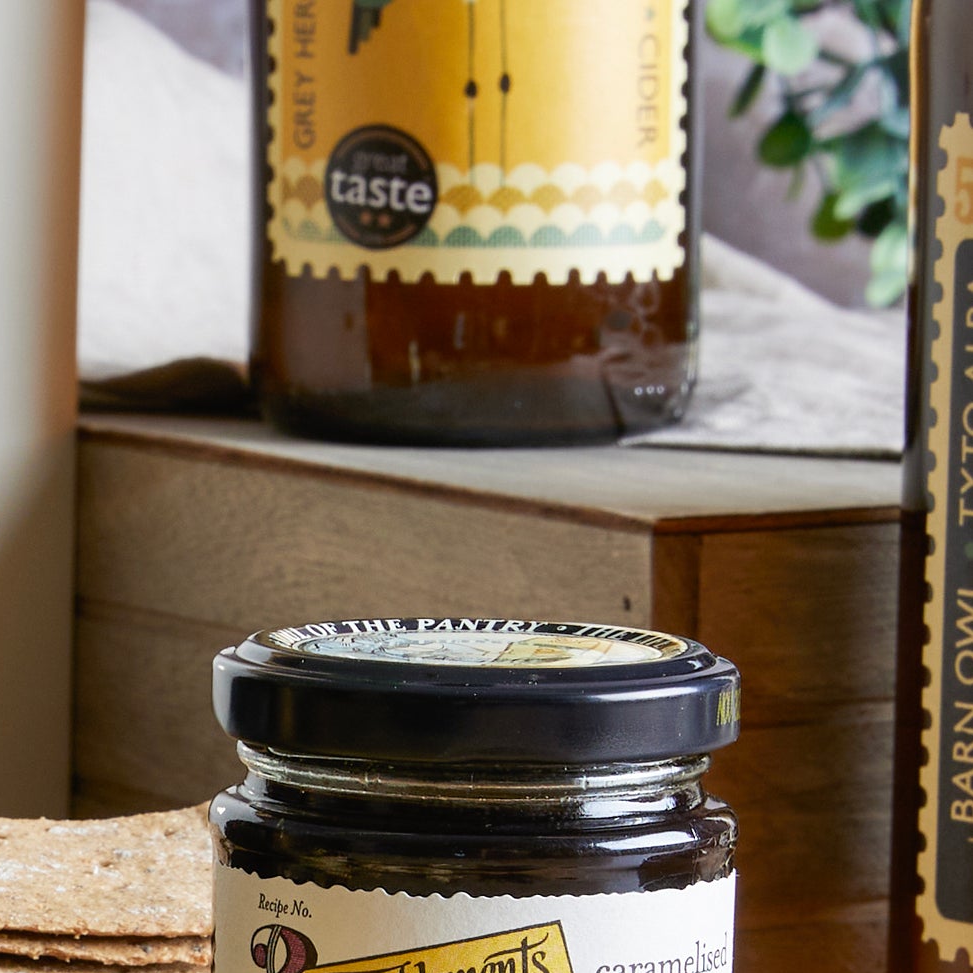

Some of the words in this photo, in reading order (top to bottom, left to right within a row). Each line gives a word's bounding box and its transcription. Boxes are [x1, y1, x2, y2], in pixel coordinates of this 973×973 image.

[293, 71, 316, 150] GREY
[635, 33, 661, 150] CIDER
[330, 168, 433, 214] taste
[305, 622, 338, 637] OF
[342, 618, 407, 634] THE
[416, 618, 549, 632] PANTRY
[951, 701, 973, 823] BARN
[258, 893, 289, 918] Recipe
[290, 899, 313, 918] No.
